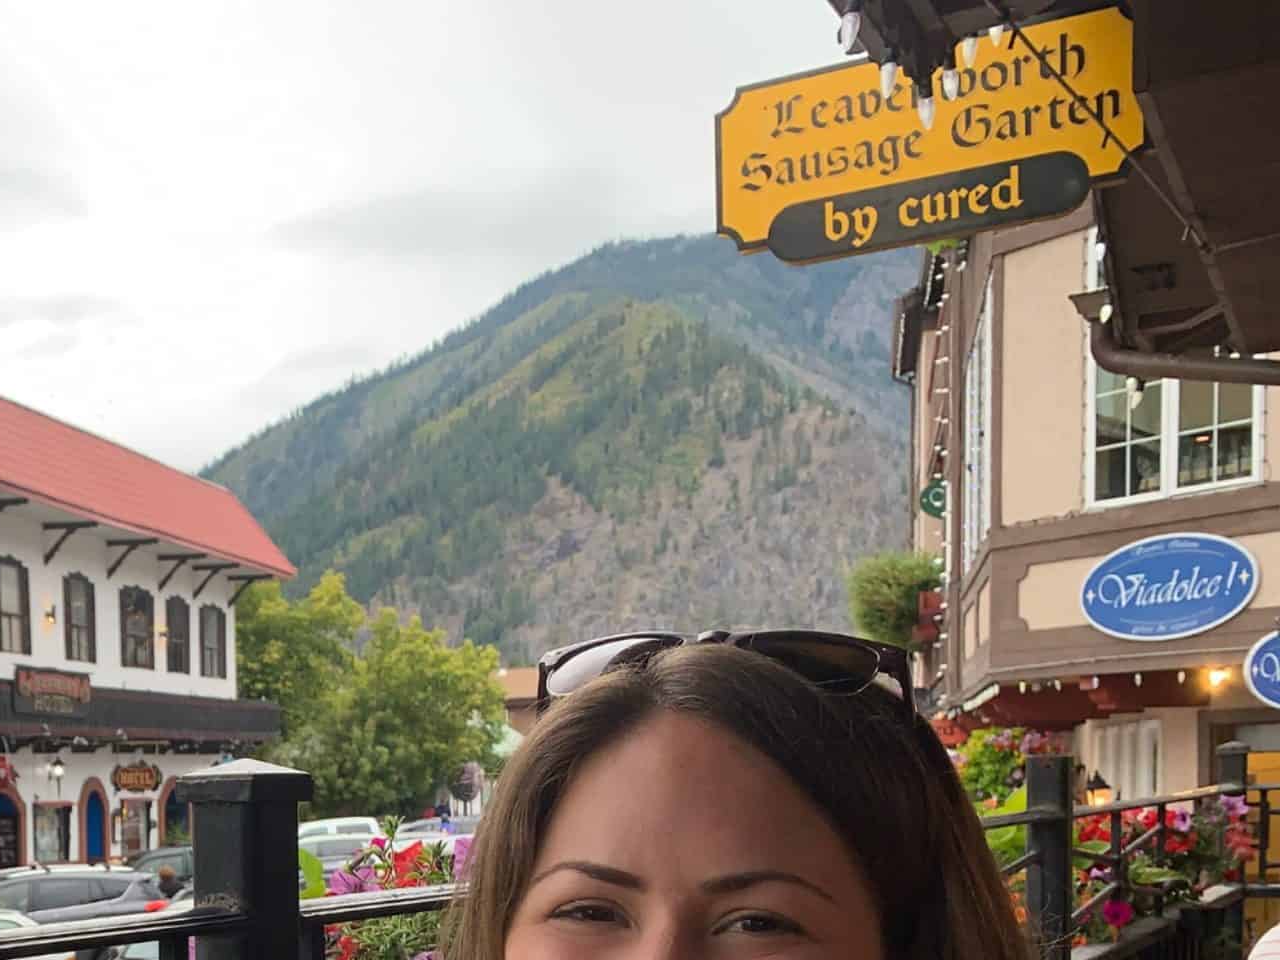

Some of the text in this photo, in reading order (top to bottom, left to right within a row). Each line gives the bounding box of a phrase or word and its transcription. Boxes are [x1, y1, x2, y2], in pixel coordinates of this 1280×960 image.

[740, 88, 1121, 193] Sausage Garten
[823, 164, 1025, 248] by cured
